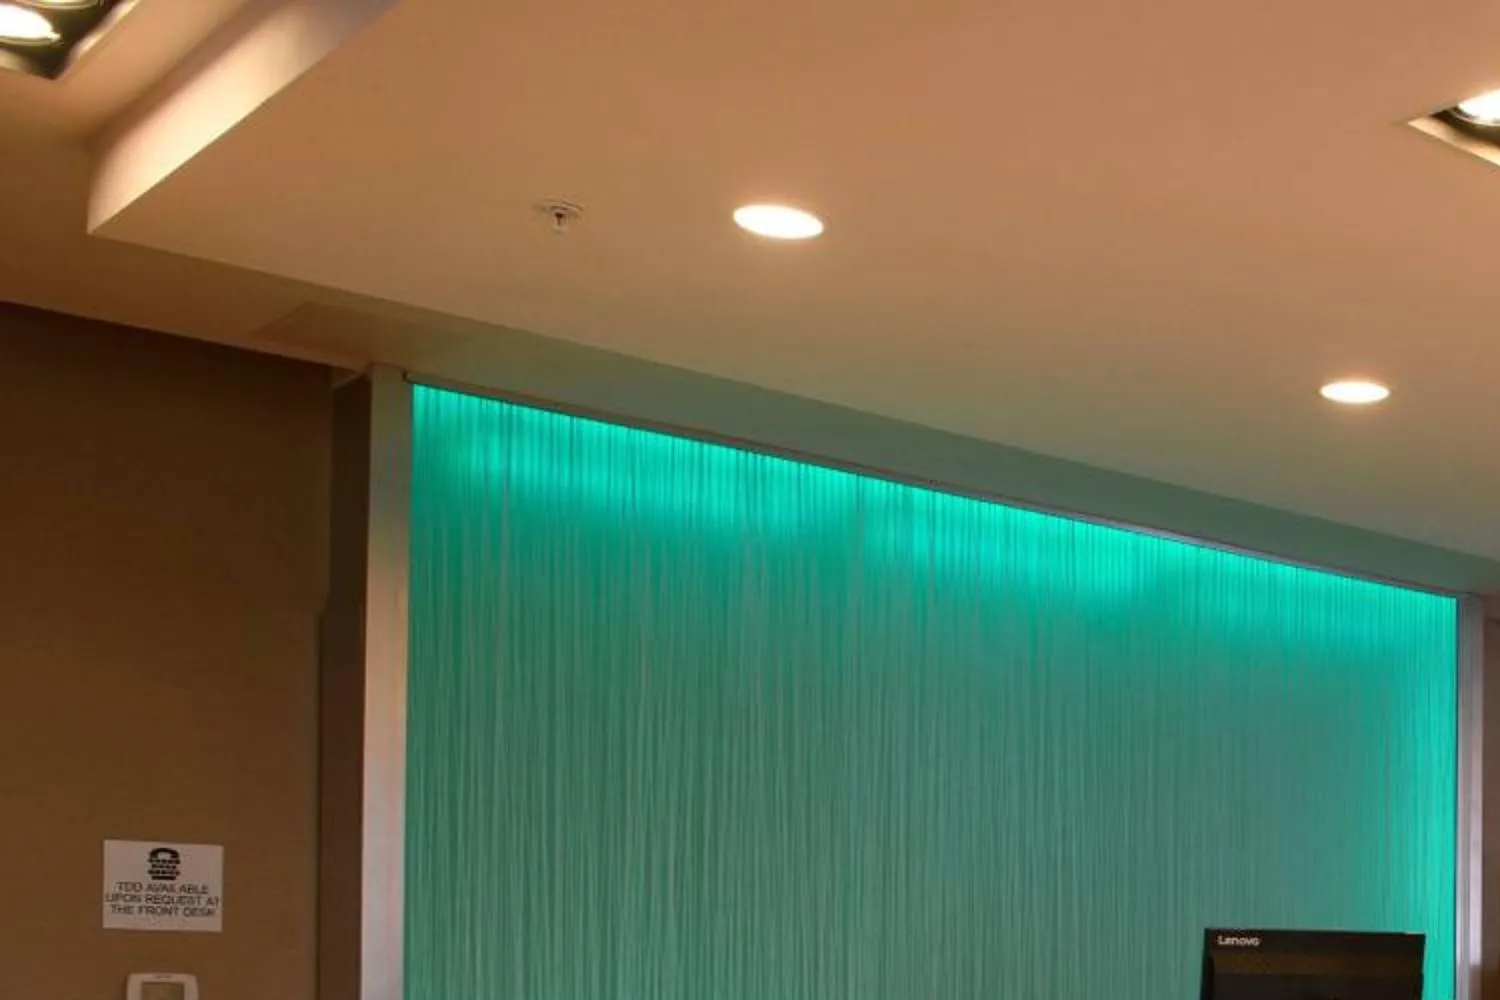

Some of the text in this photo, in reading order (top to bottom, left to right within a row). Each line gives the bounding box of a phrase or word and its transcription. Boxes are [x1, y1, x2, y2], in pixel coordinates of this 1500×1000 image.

[116, 881, 208, 895] TDD AVAILABLE
[105, 893, 219, 907] UPON REQUEST AT
[111, 904, 217, 917] THE FRONT DESK
[1217, 935, 1261, 946] Lenovo
